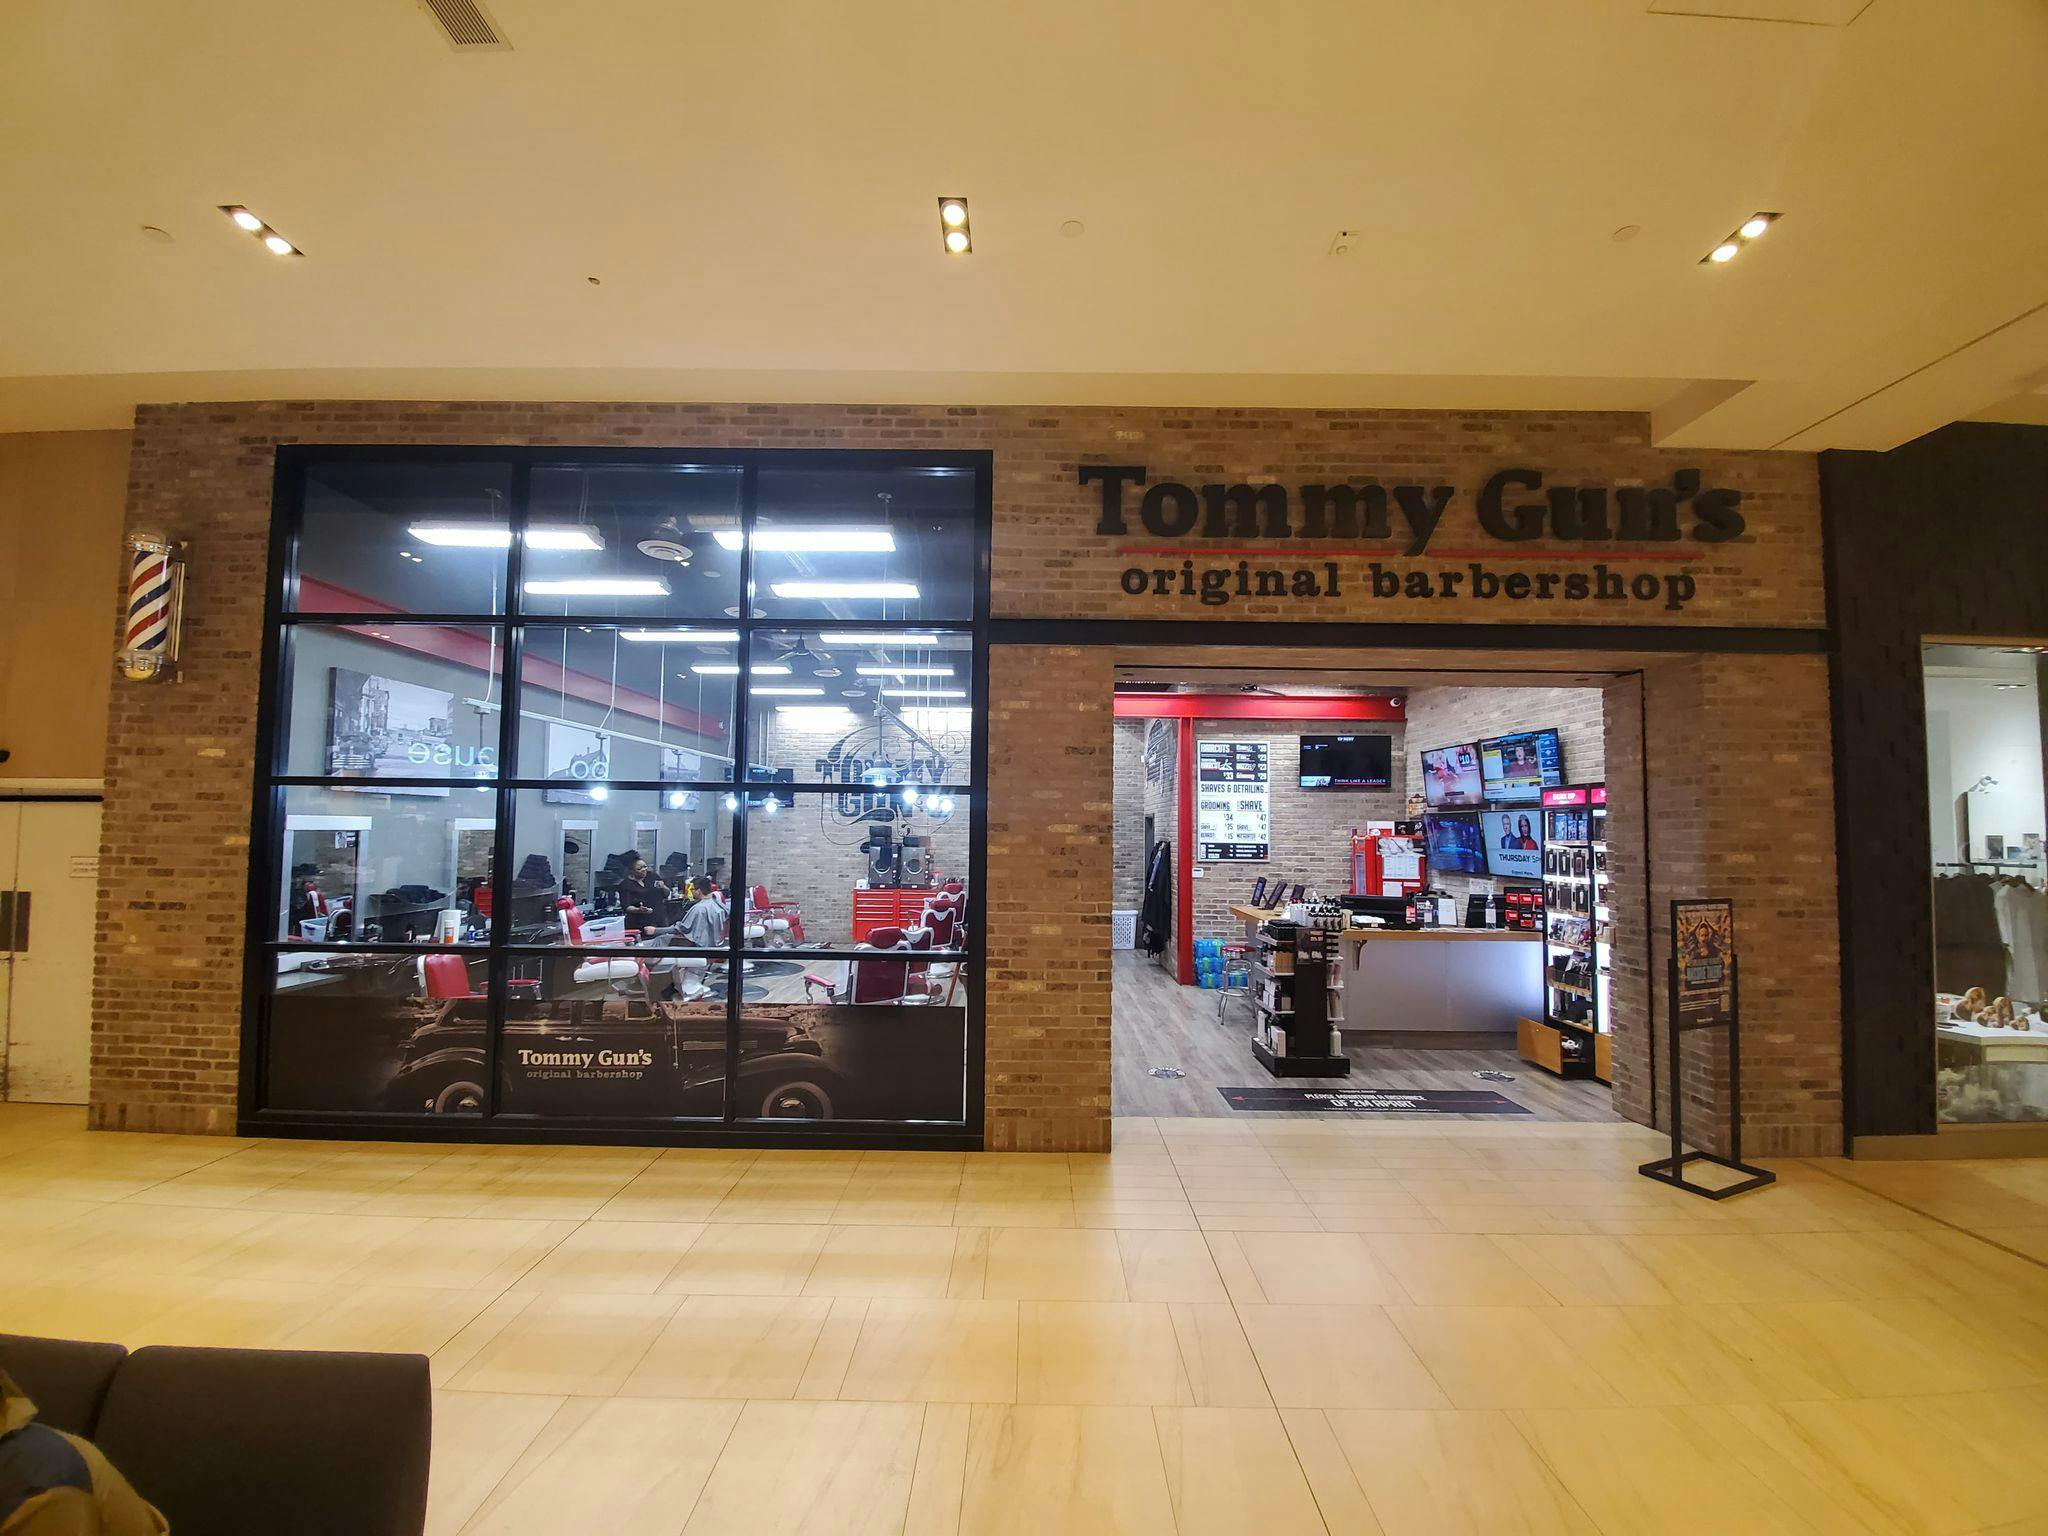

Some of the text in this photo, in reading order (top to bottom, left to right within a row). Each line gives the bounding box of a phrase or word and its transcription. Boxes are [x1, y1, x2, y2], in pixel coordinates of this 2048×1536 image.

[1079, 465, 1745, 556] Tommy Gun's
[1121, 560, 1696, 610] original barbershop
[1201, 783, 1265, 794] SHAVES & DETAILING
[1200, 801, 1231, 810] GROOMING
[1240, 800, 1263, 810] SHAVE
[1498, 853, 1531, 863] THURSDAY
[518, 1049, 653, 1069] Tommy Gun's
[527, 1069, 643, 1080] original barbershop
[1330, 1099, 1417, 1108] OF 2M APART
